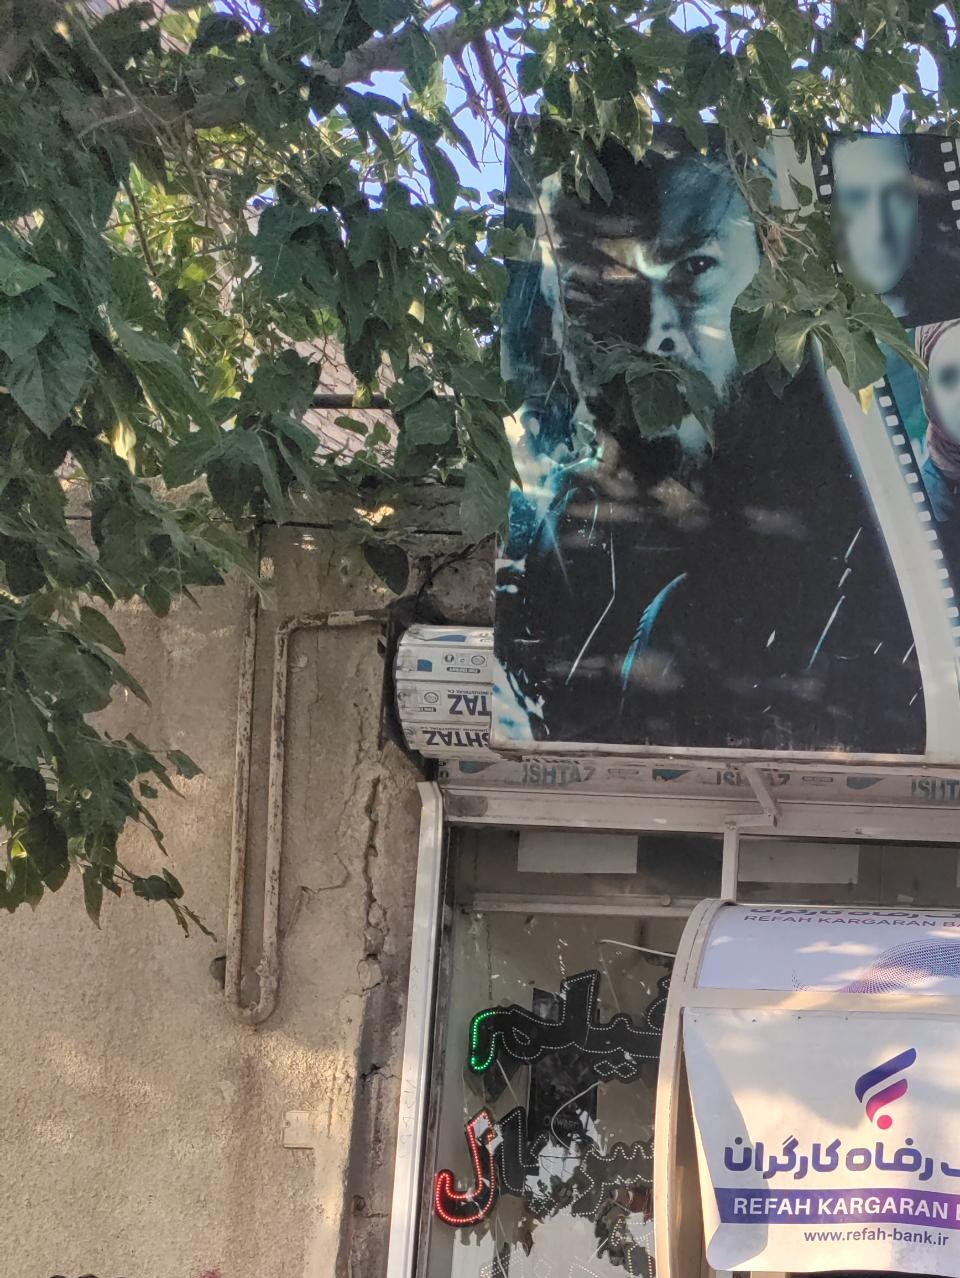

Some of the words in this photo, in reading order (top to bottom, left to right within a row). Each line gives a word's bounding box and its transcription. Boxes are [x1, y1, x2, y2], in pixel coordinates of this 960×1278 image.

[743, 915, 812, 924] REFAH
[817, 917, 936, 927] KARGARAN
[724, 1135, 841, 1180] کارگران
[846, 1137, 935, 1181] رفاه
[733, 1197, 811, 1216] REFAH
[818, 1196, 949, 1220] KARGARAN
[804, 1226, 950, 1247] www.refah-bank.ir
